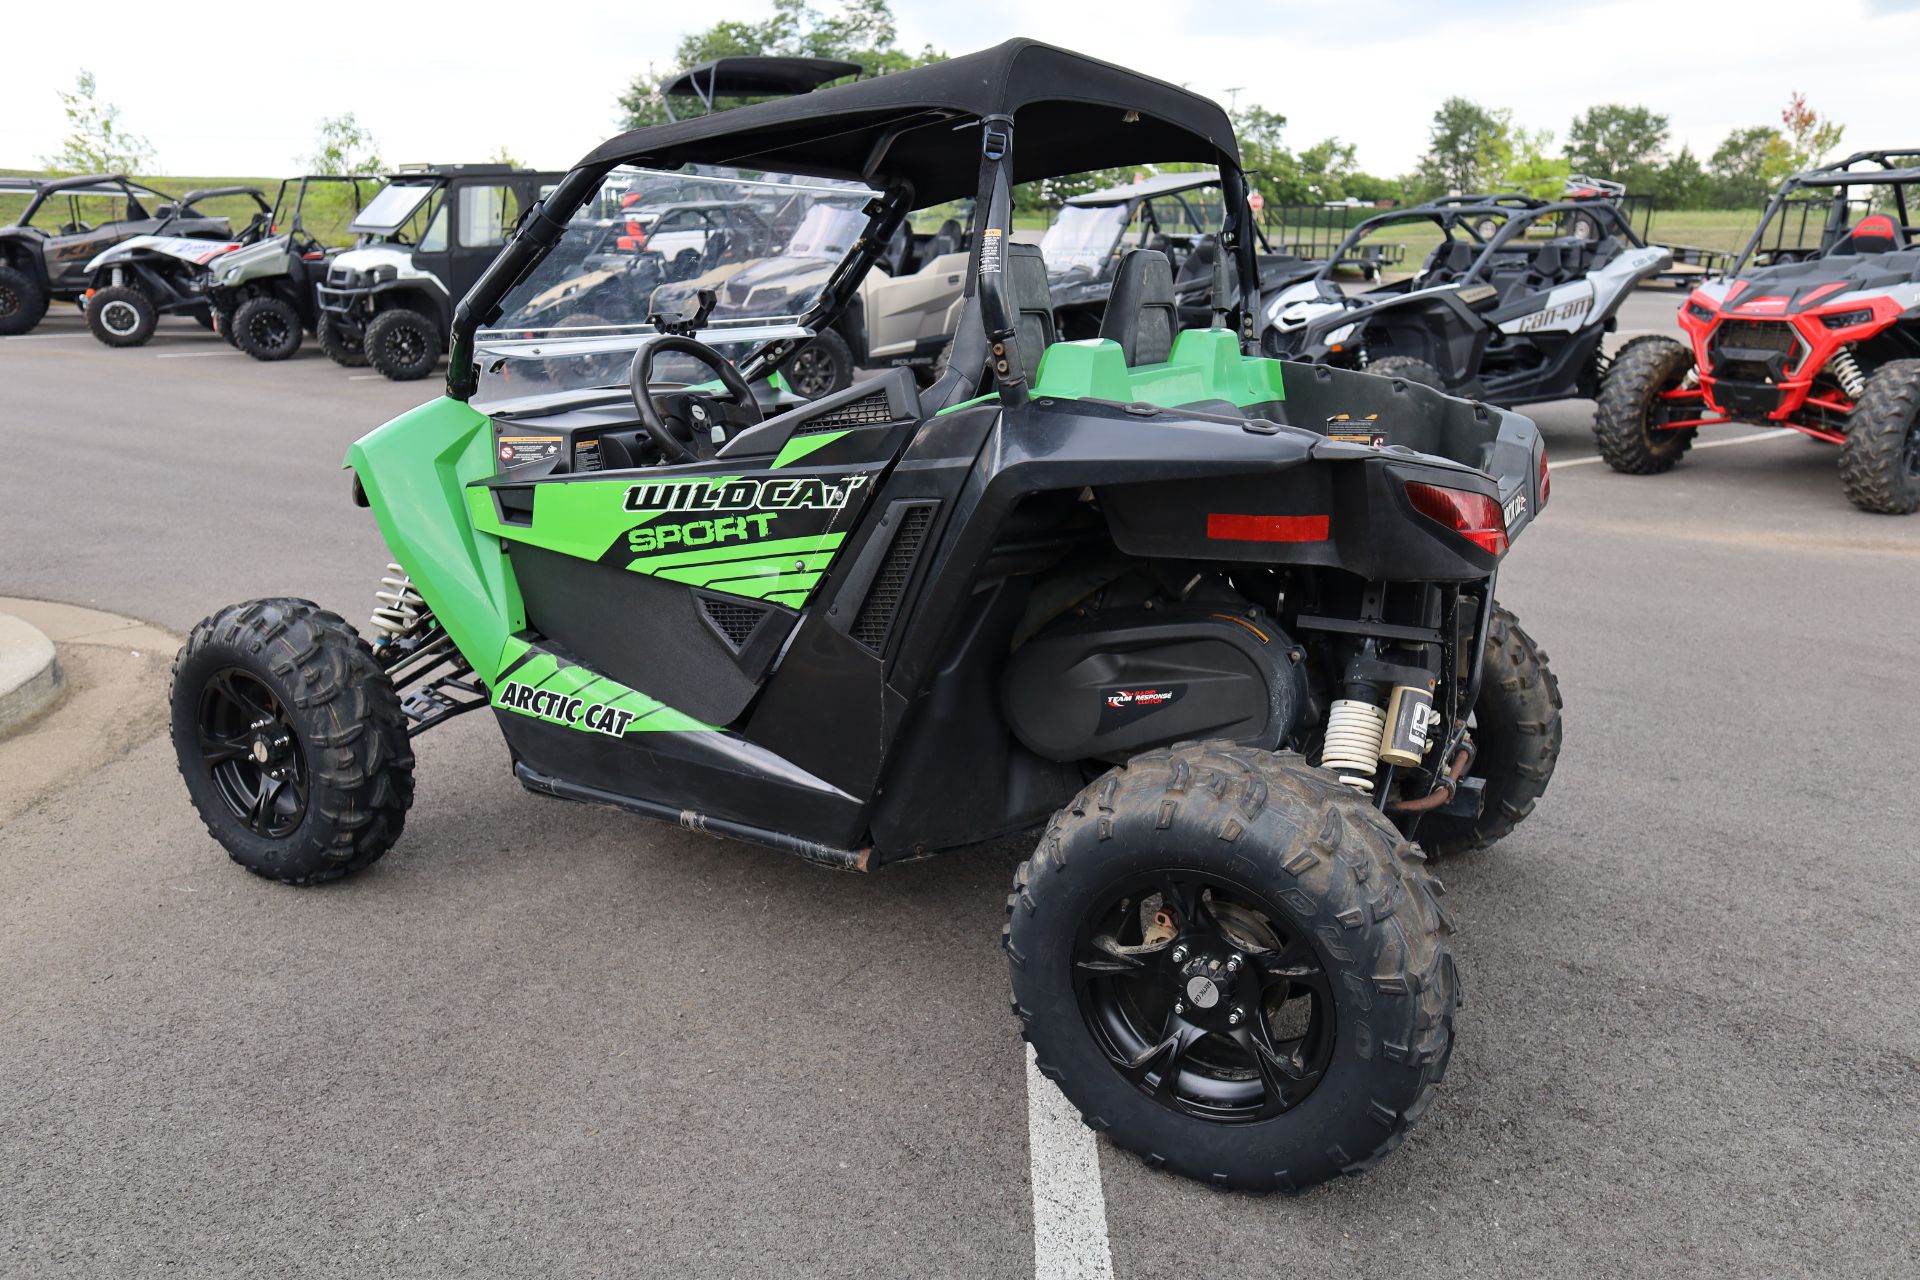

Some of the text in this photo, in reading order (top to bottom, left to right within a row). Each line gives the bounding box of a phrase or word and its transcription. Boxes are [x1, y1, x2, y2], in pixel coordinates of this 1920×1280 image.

[622, 475, 868, 513] WILDCAT
[628, 511, 778, 553] SPORT
[498, 681, 635, 738] ARCTIC CAT
[1135, 693, 1172, 702] RESPONSE
